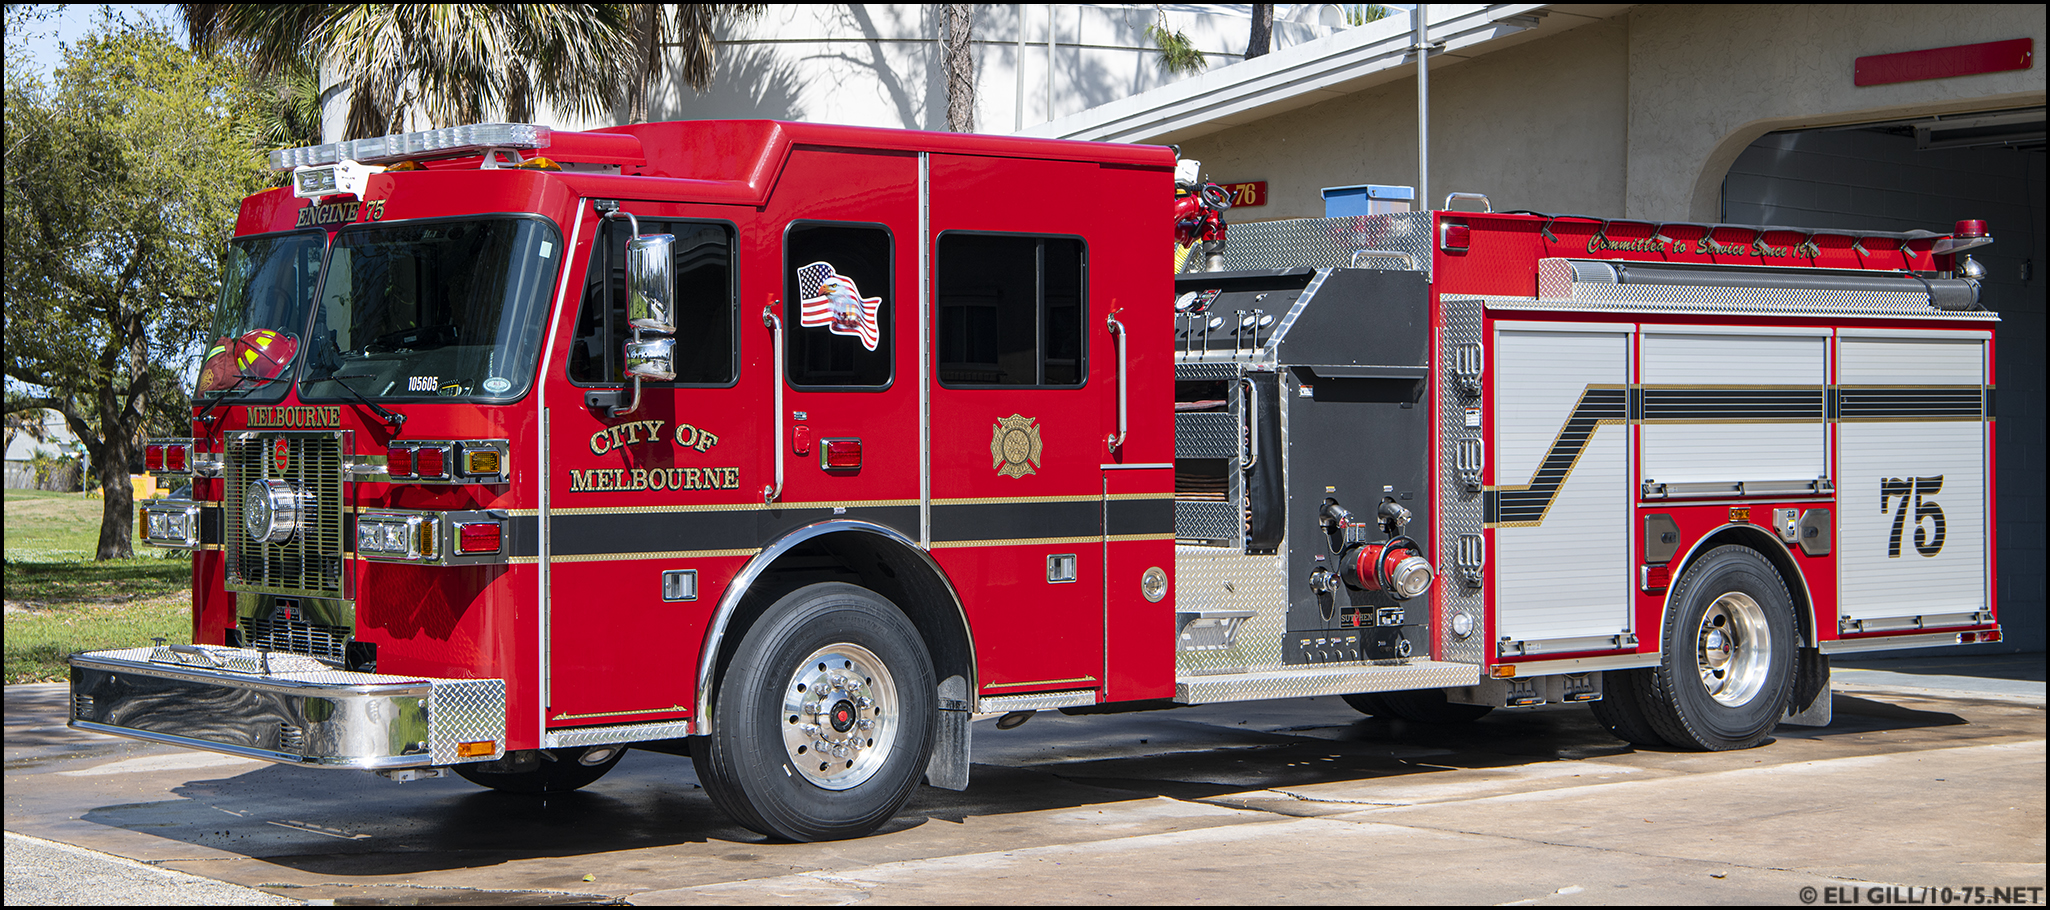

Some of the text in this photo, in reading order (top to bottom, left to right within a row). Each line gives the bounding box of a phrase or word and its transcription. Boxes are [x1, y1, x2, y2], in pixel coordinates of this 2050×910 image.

[1235, 183, 1256, 205] 76
[295, 198, 387, 228] ENGINE 75
[1586, 231, 1666, 254] Committed
[1672, 239, 1687, 254] to
[408, 376, 439, 391] 105605
[246, 405, 341, 428] MELBOURNE
[589, 420, 720, 456] CITY OF
[569, 467, 740, 492] MELBOURNE
[1880, 474, 1947, 558] 75
[1341, 612, 1374, 623] SUTPHEN
